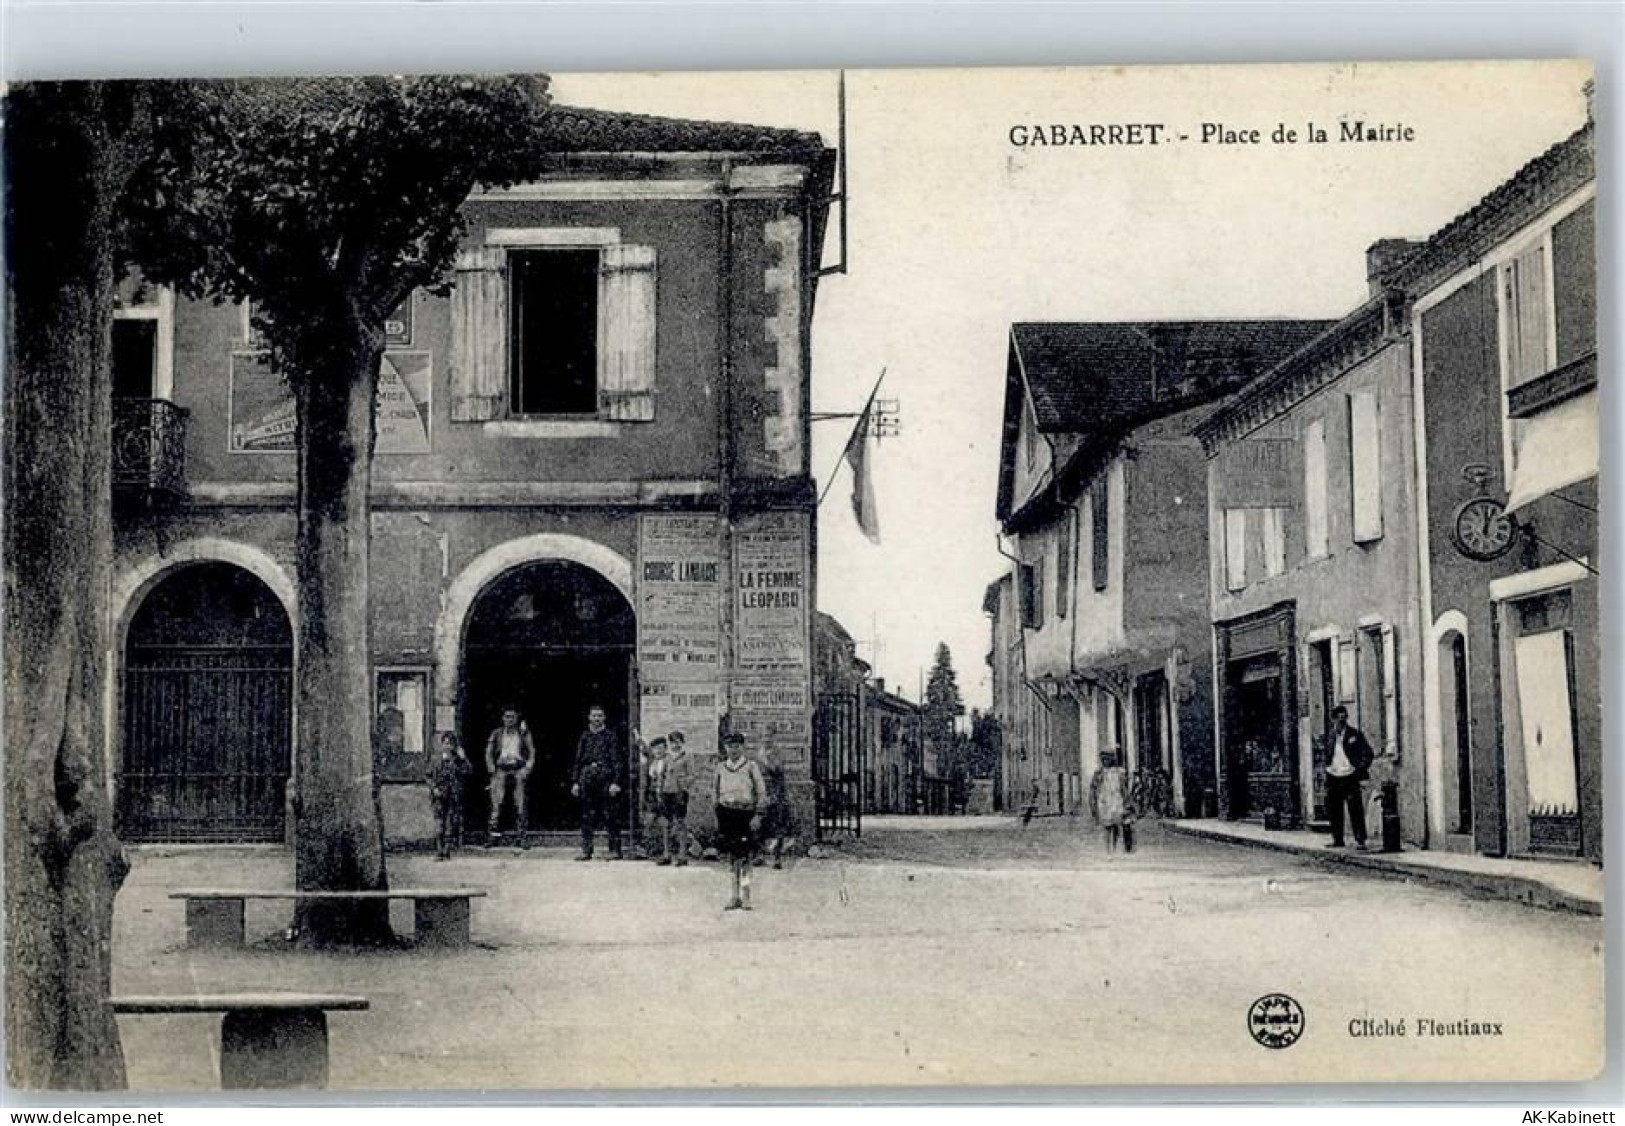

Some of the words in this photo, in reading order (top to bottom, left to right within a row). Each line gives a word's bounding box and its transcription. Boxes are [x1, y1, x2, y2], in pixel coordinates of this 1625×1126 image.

[740, 572, 754, 588] LA
[757, 572, 803, 588] FEMME
[743, 591, 799, 609] LEOPARD
